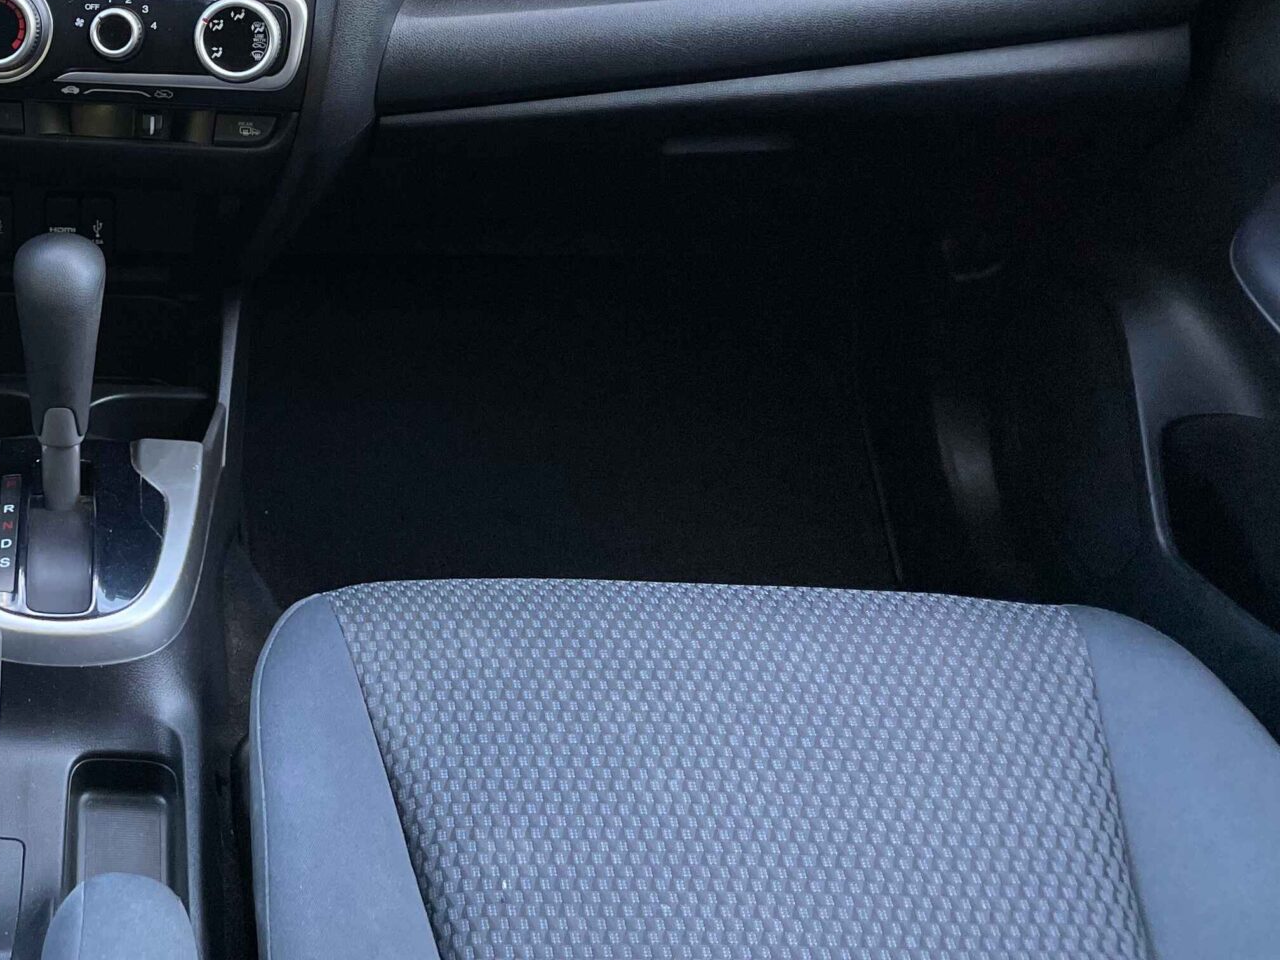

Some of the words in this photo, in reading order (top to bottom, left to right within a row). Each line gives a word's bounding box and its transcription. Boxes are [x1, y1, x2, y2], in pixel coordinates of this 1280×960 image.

[84, 3, 100, 11] OFF
[141, 5, 149, 13] 3
[150, 21, 157, 30] 4
[3, 504, 15, 513] R
[2, 521, 13, 529] N
[0, 539, 12, 548] D
[0, 557, 10, 567] S
